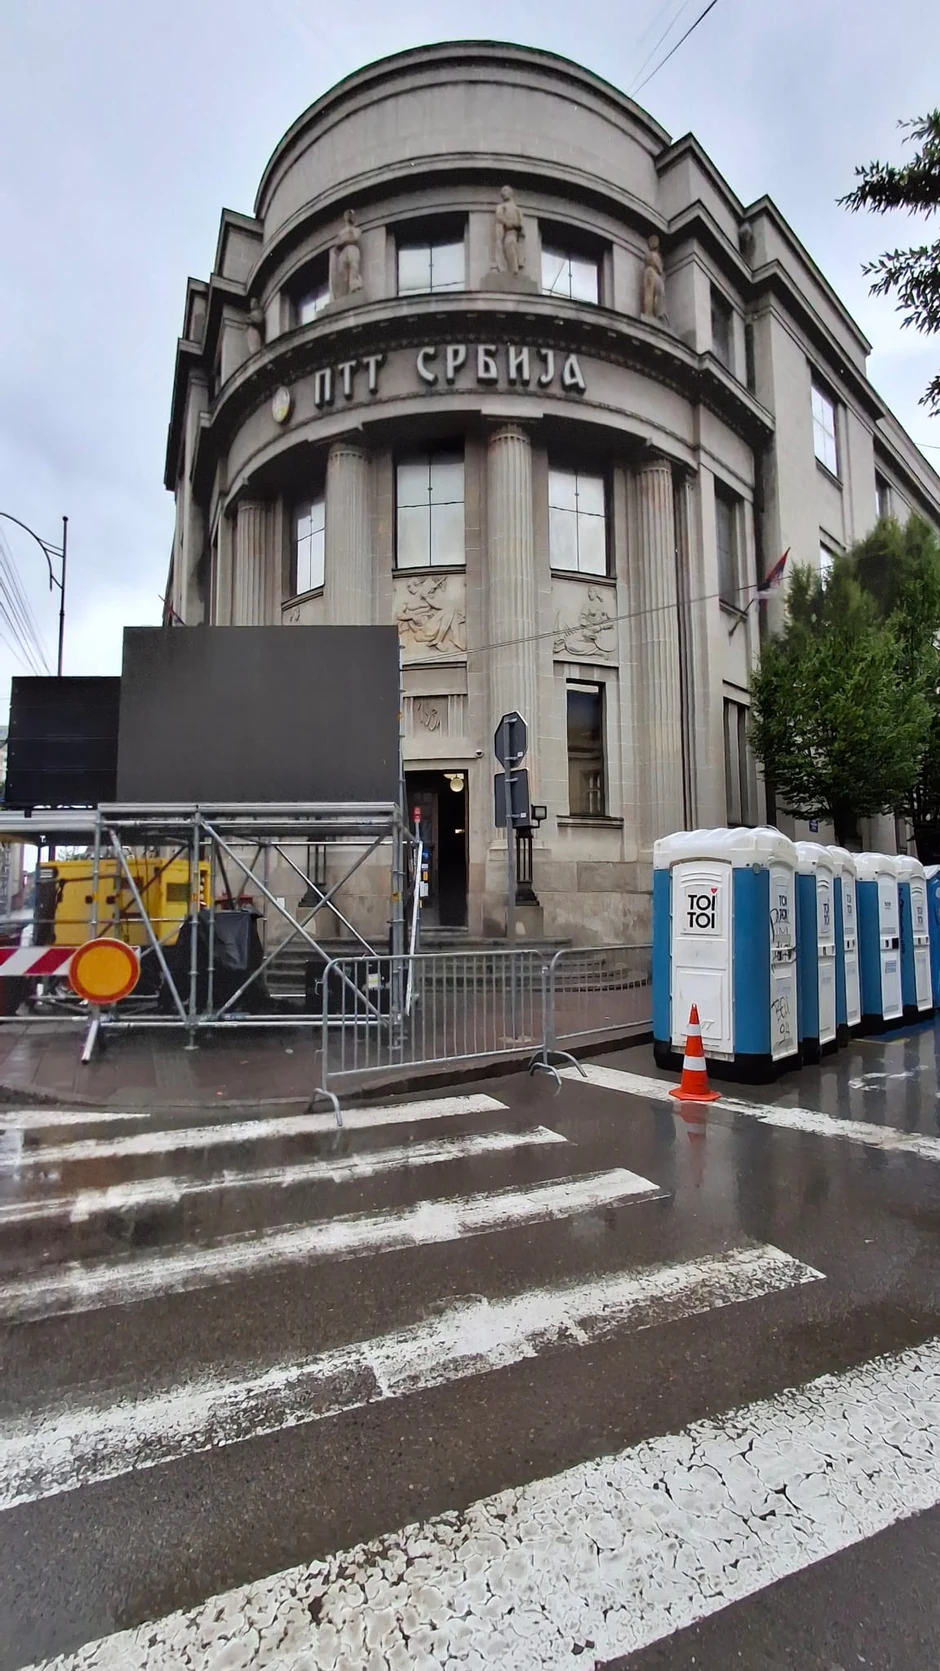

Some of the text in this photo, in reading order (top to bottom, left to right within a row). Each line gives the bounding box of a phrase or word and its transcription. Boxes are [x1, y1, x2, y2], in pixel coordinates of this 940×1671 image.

[314, 344, 587, 408] ПТТ СРБИЈА
[688, 894, 716, 911] TOI
[687, 911, 715, 929] TOI
